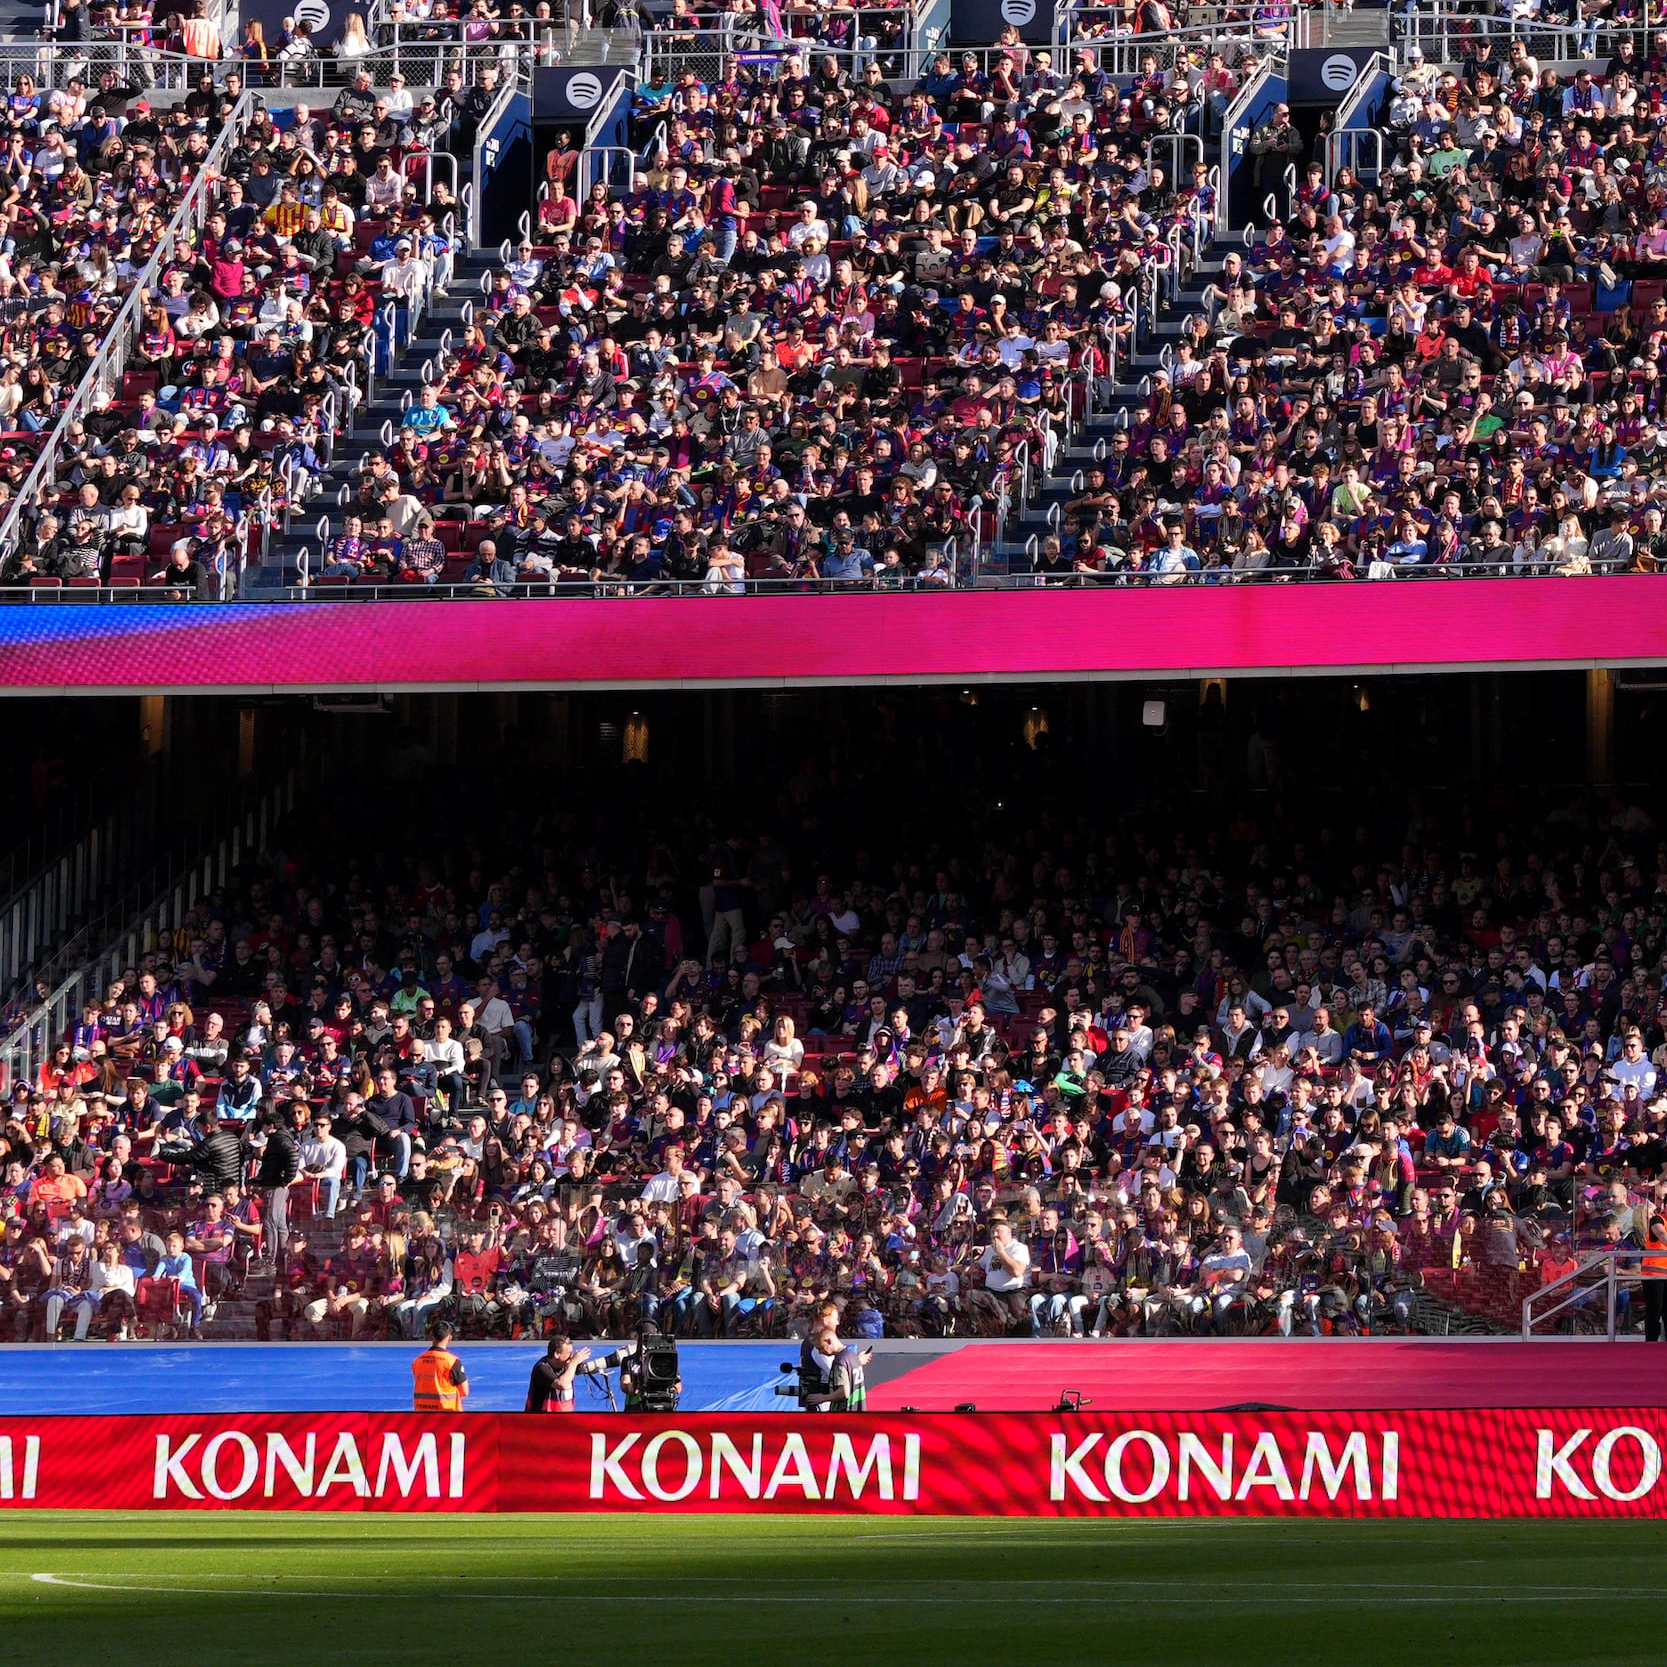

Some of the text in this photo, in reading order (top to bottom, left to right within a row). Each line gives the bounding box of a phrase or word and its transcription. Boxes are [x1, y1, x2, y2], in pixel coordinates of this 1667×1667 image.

[154, 1430, 466, 1501] KONAMI
[590, 1430, 921, 1503] KONAMI
[1050, 1429, 1398, 1504] KONAMI
